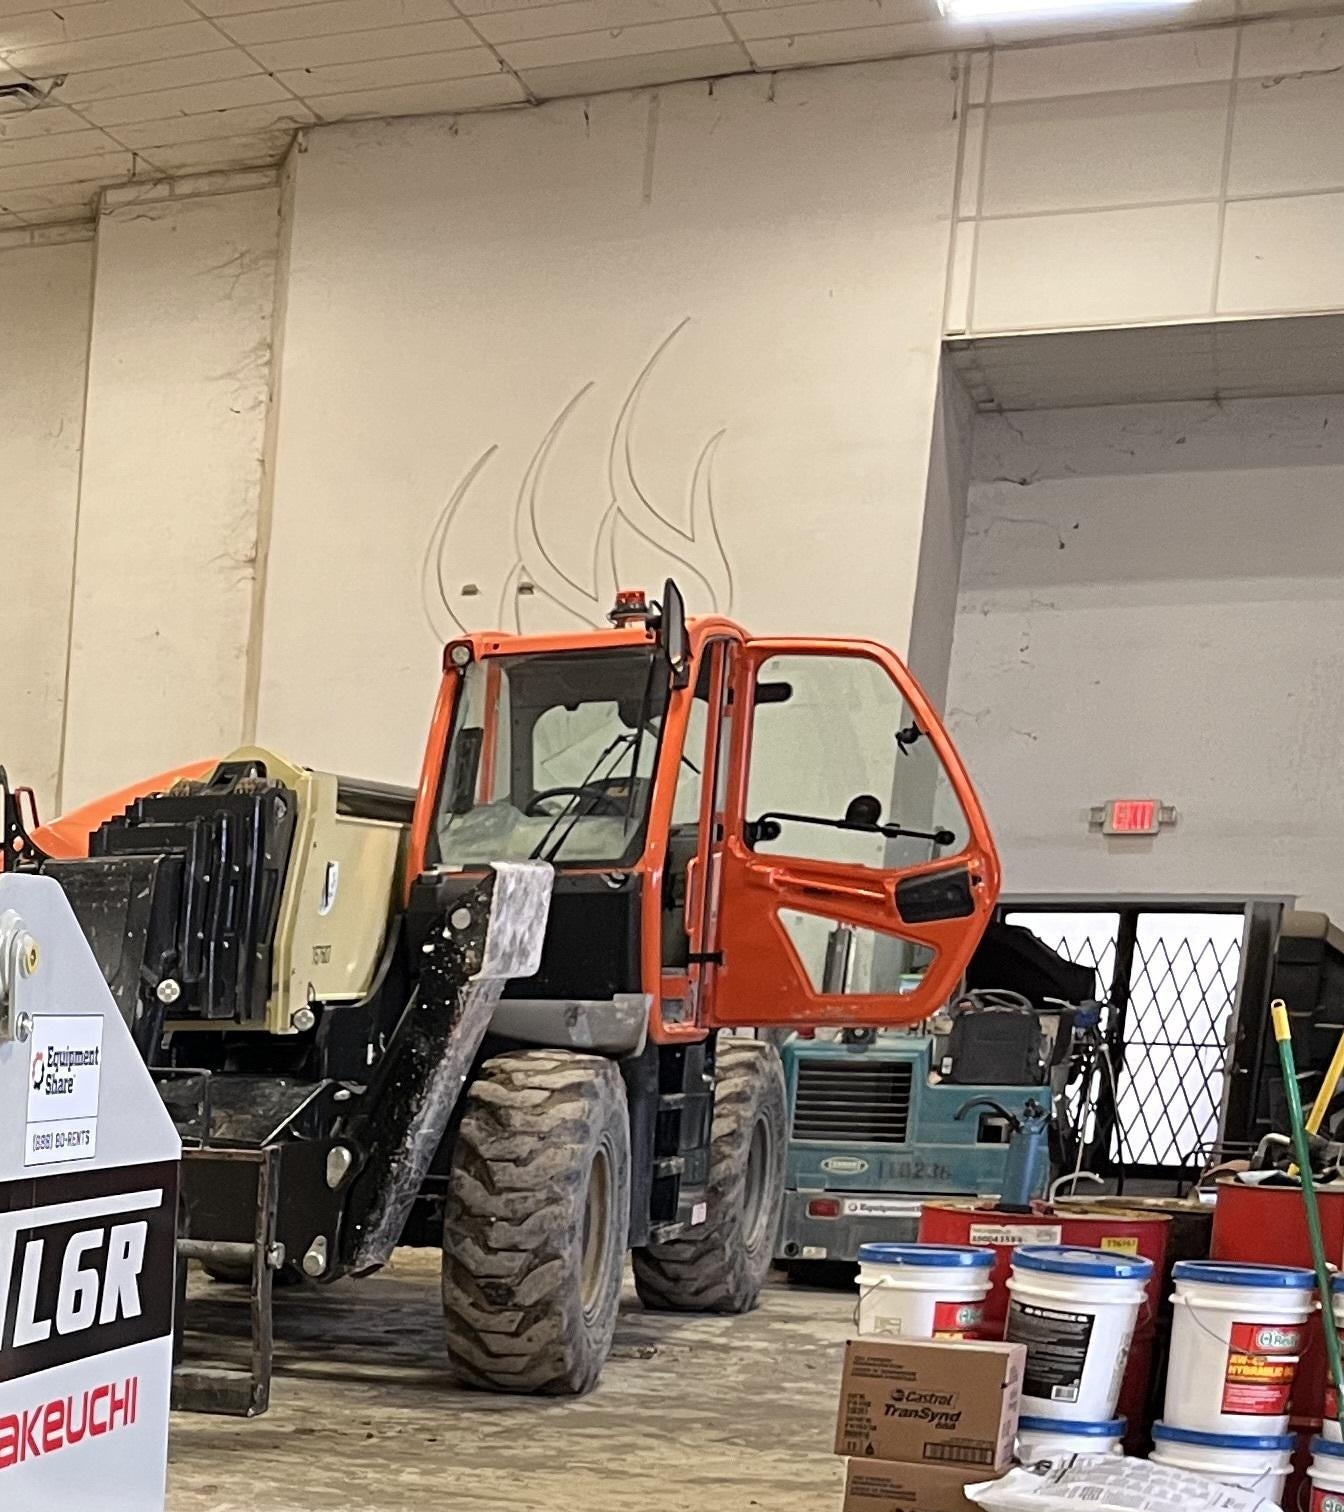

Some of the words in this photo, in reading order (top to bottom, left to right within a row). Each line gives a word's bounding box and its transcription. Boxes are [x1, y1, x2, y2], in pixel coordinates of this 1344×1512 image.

[46, 1045, 99, 1072] Equipment
[45, 1073, 74, 1095] Share
[905, 1391, 954, 1406] Castrol
[884, 1403, 962, 1423] TranSynd
